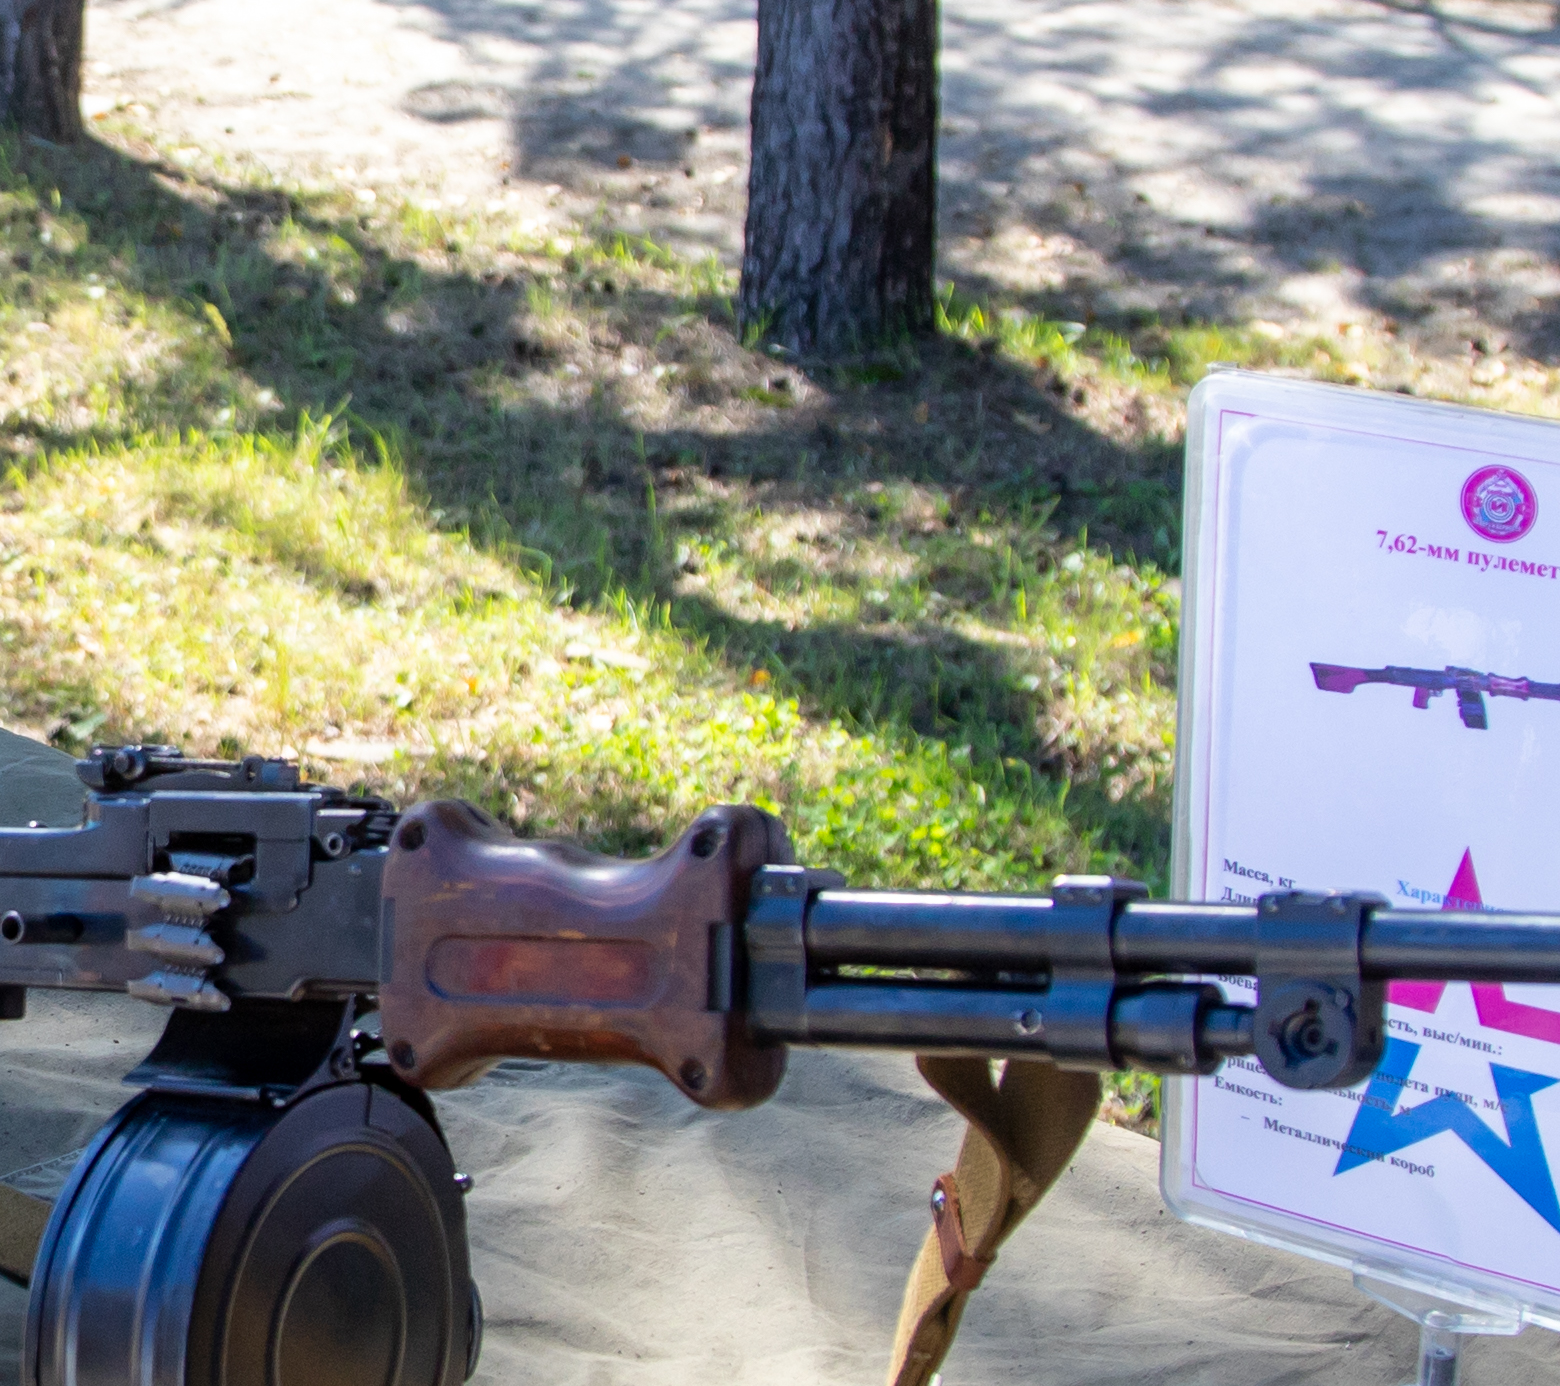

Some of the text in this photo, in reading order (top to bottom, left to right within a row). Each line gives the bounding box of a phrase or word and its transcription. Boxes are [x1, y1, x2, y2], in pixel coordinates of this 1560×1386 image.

[1376, 529, 1460, 562] 7,62-мм
[1467, 550, 1560, 580] пулемет
[1223, 858, 1296, 889] Масса, кг
[1387, 1018, 1418, 1037] сть,
[1214, 1074, 1283, 1106] Емкость:
[1263, 1116, 1436, 1178] Металлический короб
